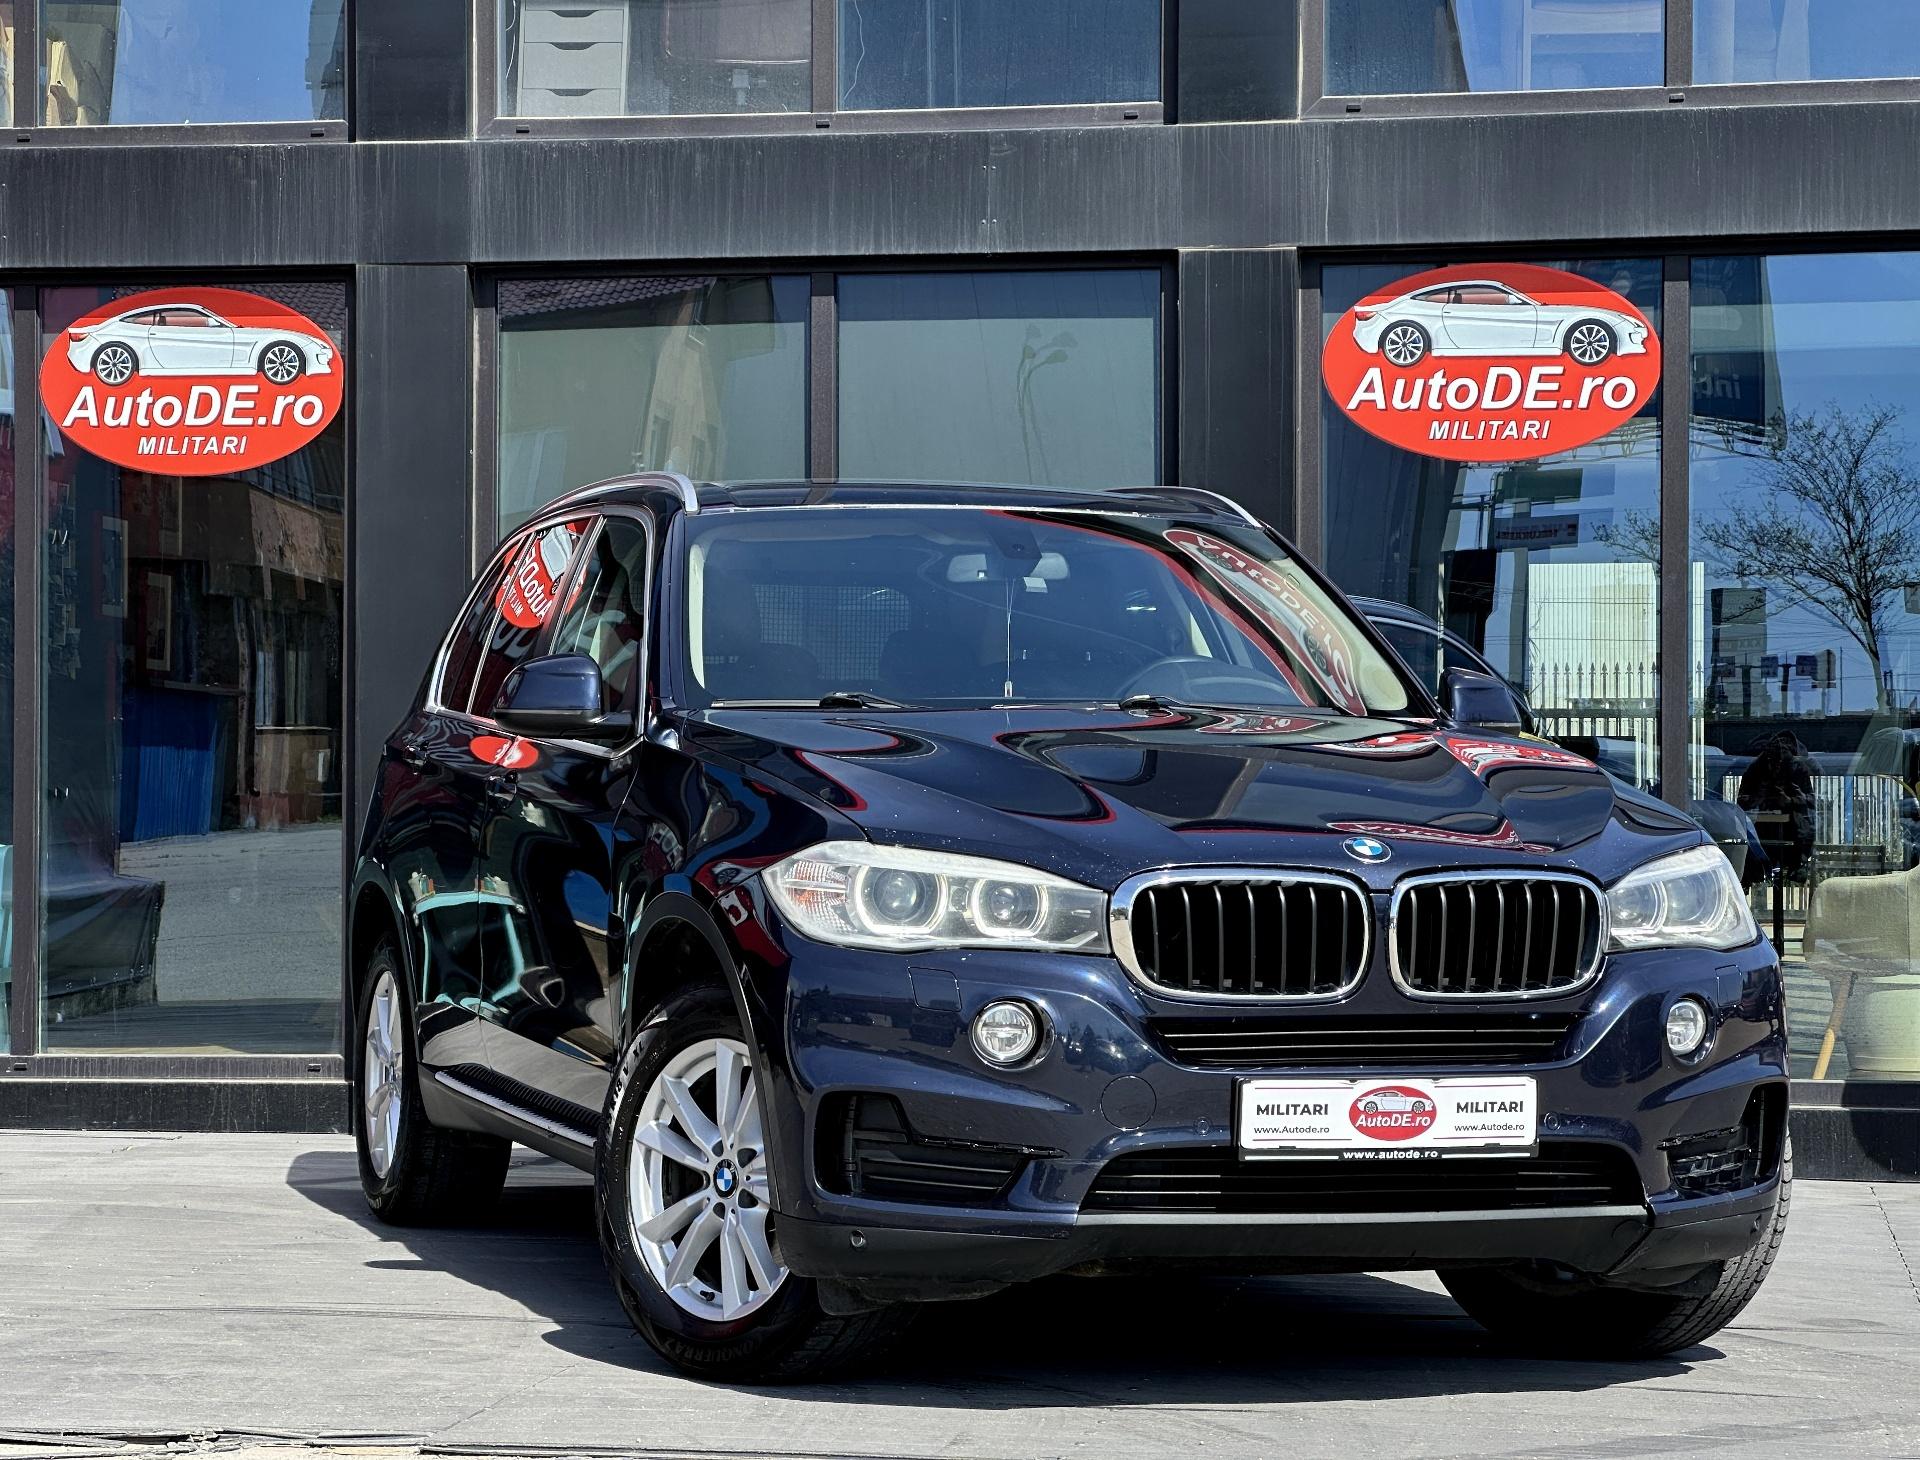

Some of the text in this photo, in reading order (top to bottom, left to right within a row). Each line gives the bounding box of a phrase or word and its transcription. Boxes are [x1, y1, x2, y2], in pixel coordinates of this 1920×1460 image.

[1346, 364, 1637, 411] AutoDE.ro
[62, 385, 324, 427] AutoDE.ro
[1428, 419, 1551, 441] MILITARI
[137, 436, 248, 456] MILITARI
[1256, 1103, 1329, 1116] MILITARI
[1456, 1100, 1524, 1114] MILITARI
[1355, 1113, 1431, 1128] AutoDE.ro
[1454, 1122, 1525, 1132] www.Autode.ro
[1254, 1125, 1330, 1135] www.Autode.ro
[1343, 1150, 1439, 1160] www.autode.ro
